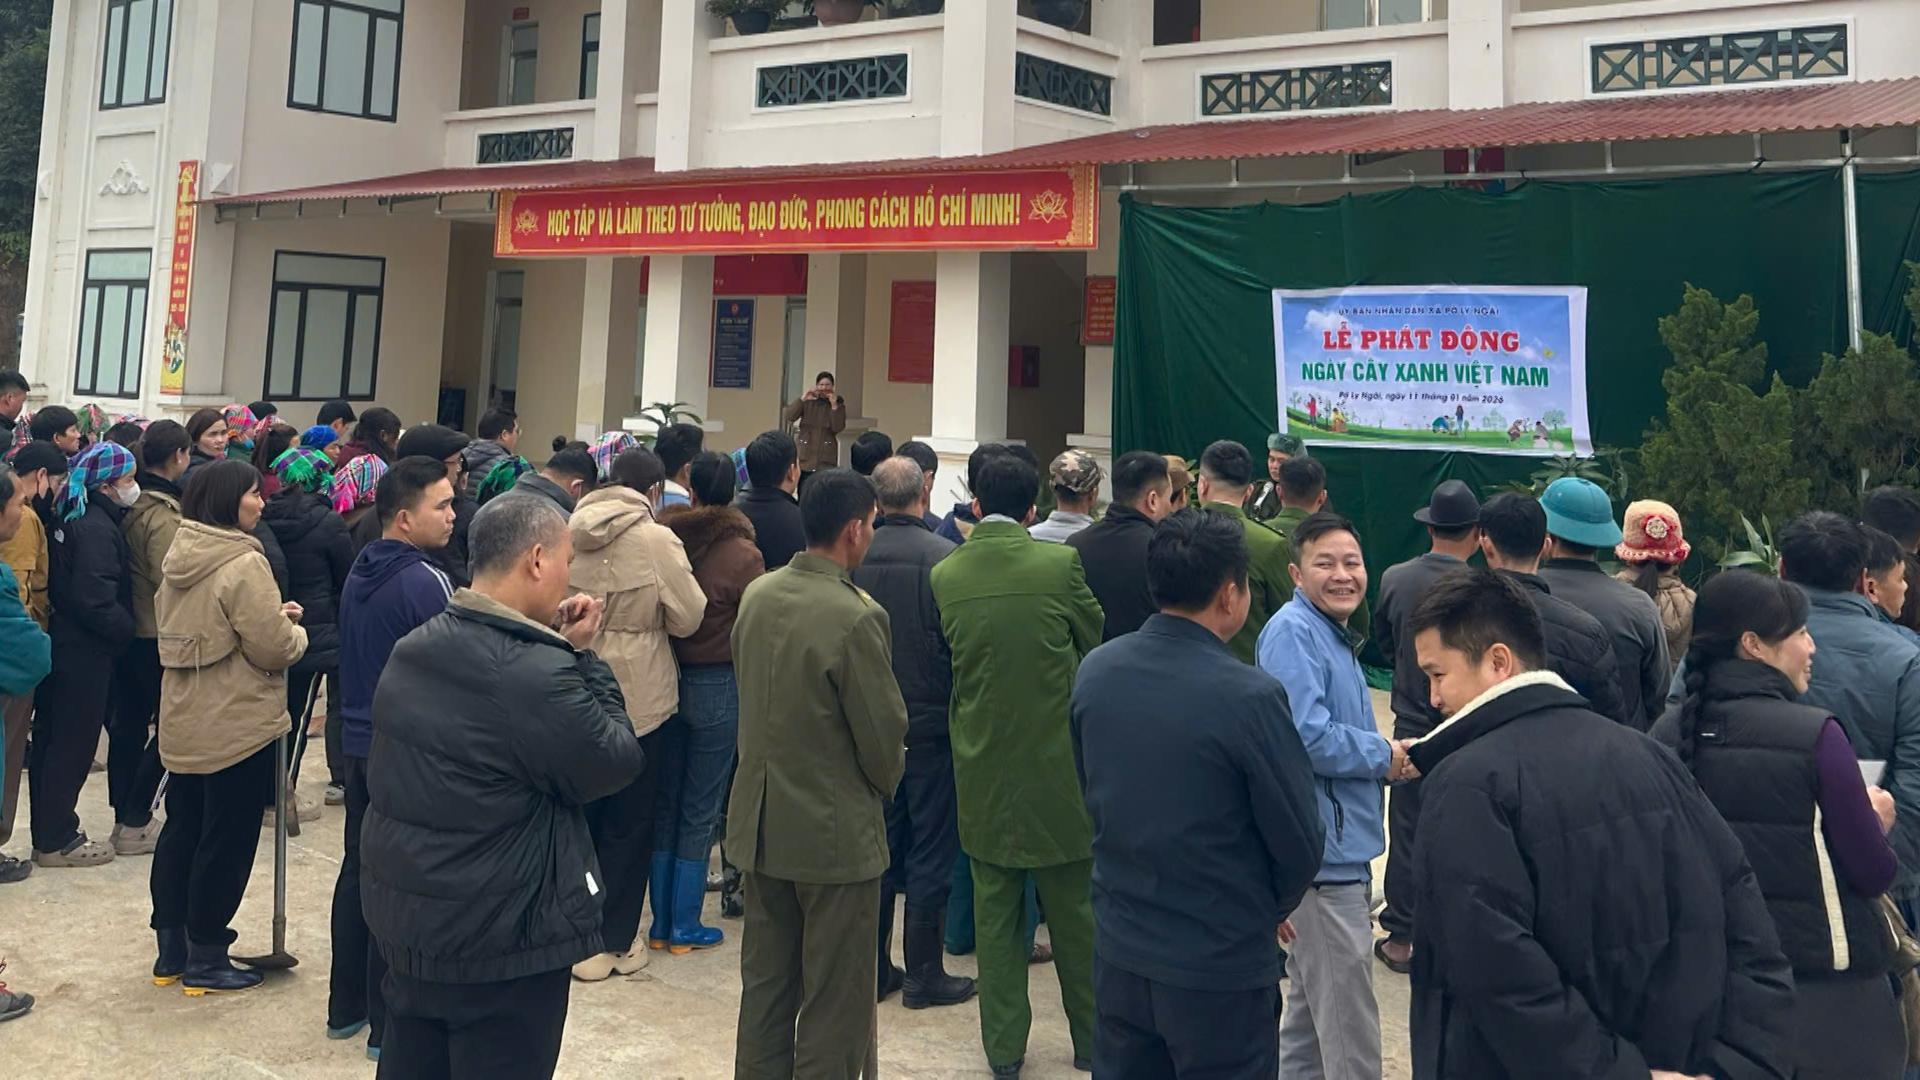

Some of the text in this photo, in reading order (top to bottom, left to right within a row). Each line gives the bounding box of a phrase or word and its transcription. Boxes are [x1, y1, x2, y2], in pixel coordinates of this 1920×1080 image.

[547, 184, 1021, 242] HỌC TẬP VÀ LÀM THEO TƯ TƯỞNG, ĐẠO ĐỨC, PHONG CÁCH HỒ CHÍ MINH!
[1323, 321, 1520, 356] LỄ PHÁT ĐỘNG
[1302, 358, 1549, 388] NGÀY CÂY XANH VIỆT NAM
